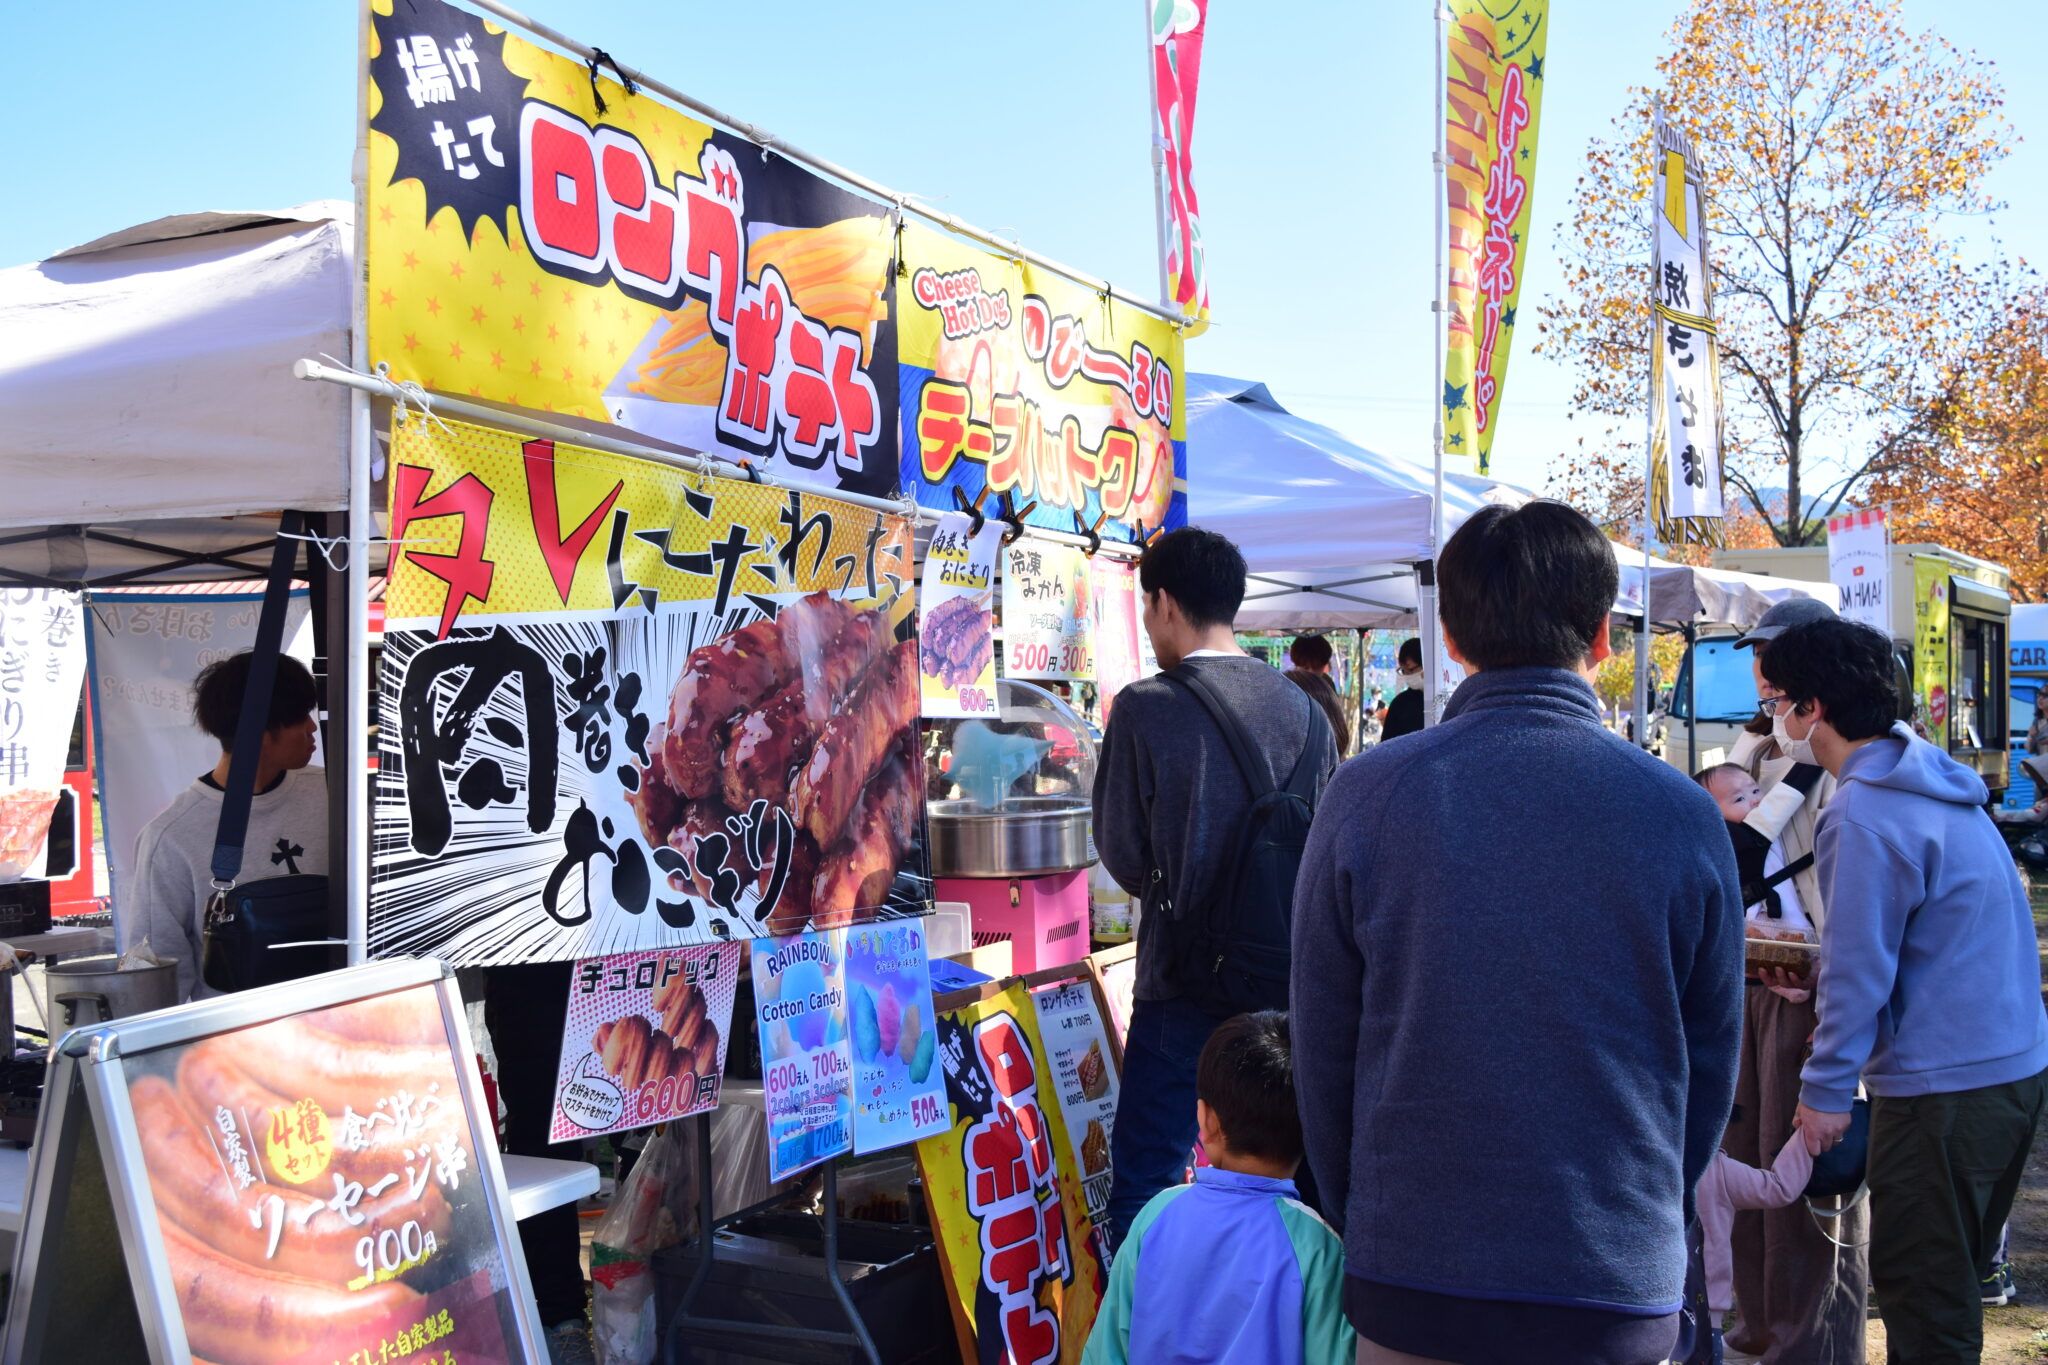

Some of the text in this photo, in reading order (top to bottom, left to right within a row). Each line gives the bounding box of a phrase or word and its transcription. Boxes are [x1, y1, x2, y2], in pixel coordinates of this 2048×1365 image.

[397, 33, 481, 108] 揚げ
[430, 115, 505, 180] たて
[524, 102, 742, 328] ロング
[917, 275, 979, 303] Cheese
[943, 296, 1008, 333] Hot Dog
[722, 270, 878, 468] ポテト
[387, 440, 902, 639] タレにこだわった
[930, 530, 969, 557] 肉巻き
[940, 560, 990, 588] おにぎり
[1010, 551, 1042, 577] 冷凍
[1022, 576, 1064, 600] みかん
[41, 588, 82, 682] 巻き
[1011, 644, 1092, 672] 500円 300円
[959, 688, 995, 712] 600円
[399, 630, 558, 857] 肉
[542, 798, 793, 928] おにぎり
[580, 952, 719, 993] チュロドック
[767, 940, 830, 977] RAINBOW
[762, 986, 842, 1023] Cotton Candy
[1041, 990, 1084, 1011] ロングポテト
[770, 1050, 848, 1093] 600えん 700えん
[940, 1029, 963, 1079] 揚げ
[863, 1069, 885, 1083] らむね
[883, 1079, 904, 1093] いちご
[965, 1067, 987, 1103] たて
[569, 1083, 621, 1107] お好みでケチャップ
[637, 1073, 717, 1119] 600円
[771, 1077, 849, 1116] 2colors 3colors
[867, 1100, 889, 1111] れもん
[911, 1095, 945, 1128] 500えん
[271, 1099, 325, 1149] 4種
[342, 1082, 440, 1151] 食べ比べ
[216, 1105, 256, 1190] 自家製
[816, 1124, 849, 1152] 700えん
[285, 1147, 326, 1176] セット
[248, 1128, 468, 1260] ソーセージ串
[355, 1220, 438, 1282] 900円
